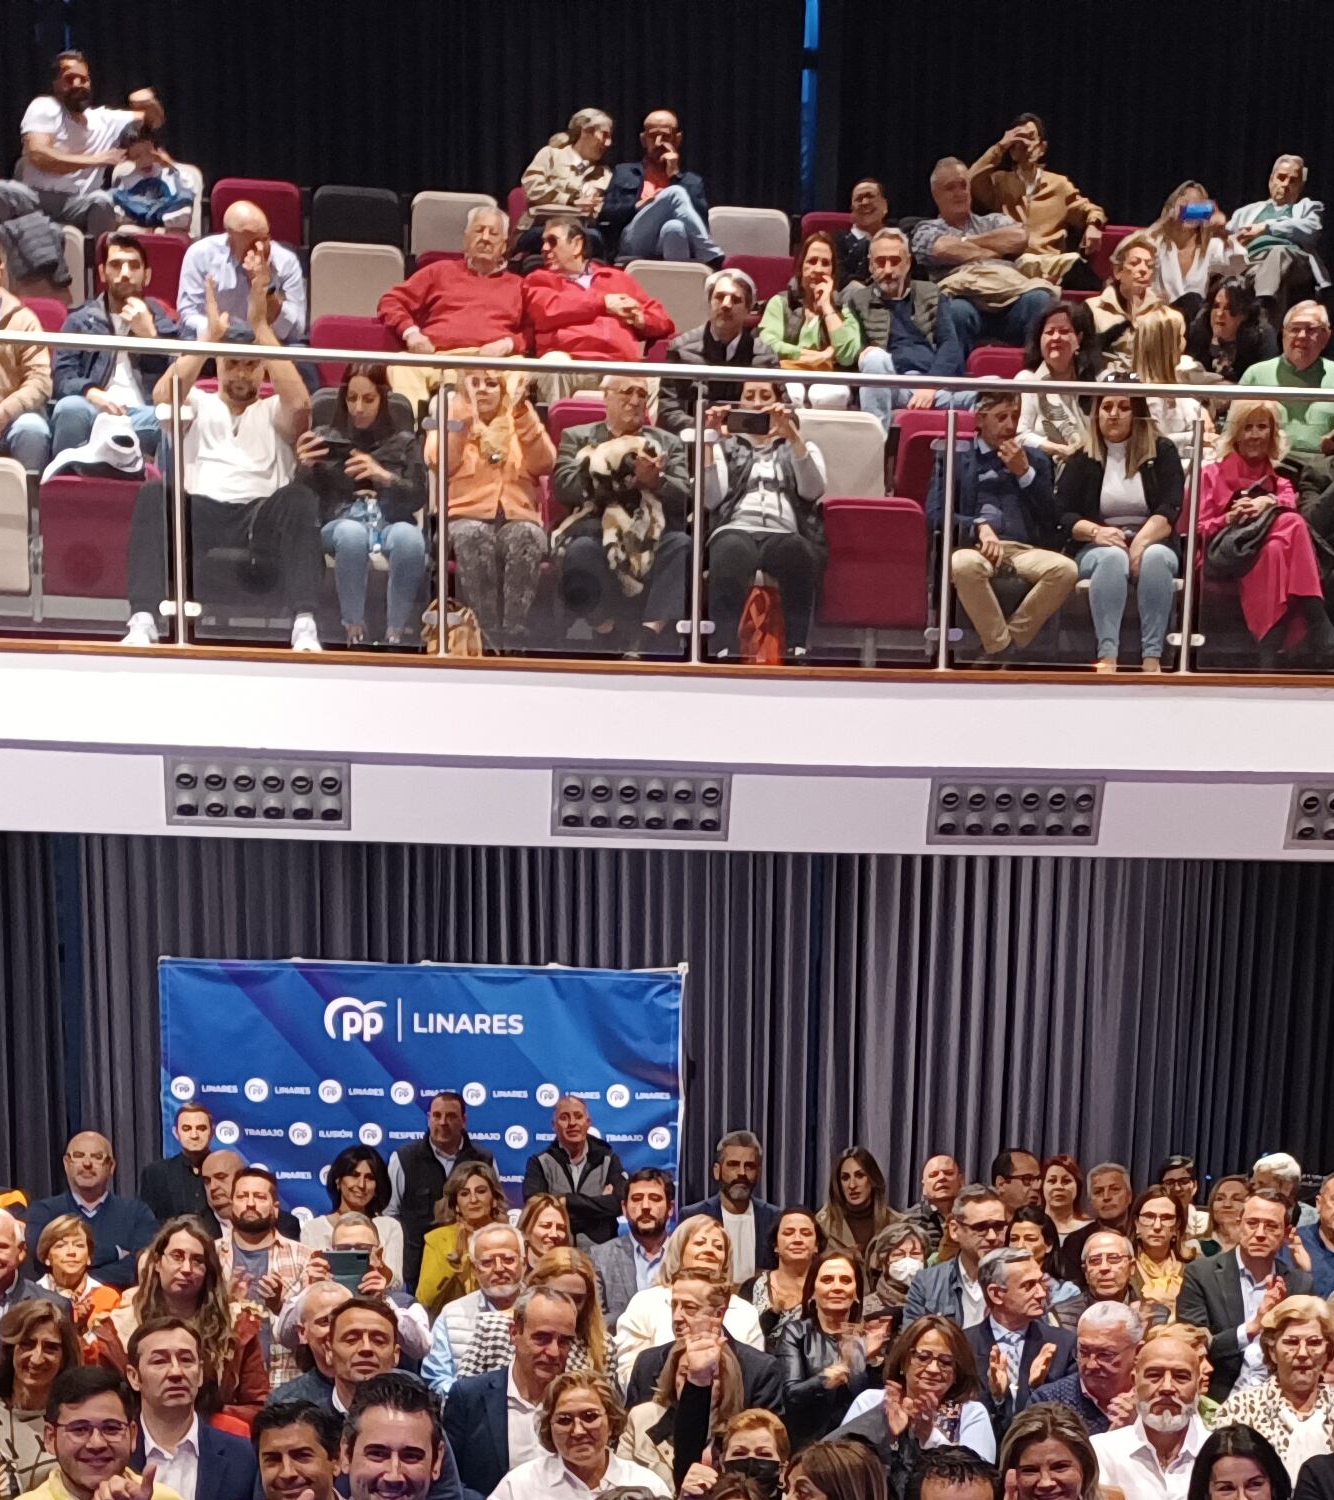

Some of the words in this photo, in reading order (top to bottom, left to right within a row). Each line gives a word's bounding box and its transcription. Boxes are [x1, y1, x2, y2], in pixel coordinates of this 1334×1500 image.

[413, 1012, 524, 1035] LINARES
[201, 1084, 238, 1094] LINARES
[274, 1086, 311, 1096] LINARES
[348, 1087, 385, 1097] LINARES
[492, 1090, 529, 1099] LINARES
[635, 1091, 671, 1101] LINARES
[244, 1128, 284, 1138] TRABAJO
[468, 1132, 501, 1141] RABAJO
[605, 1133, 644, 1143] TRABAJO
[275, 1170, 312, 1180] LINARES
